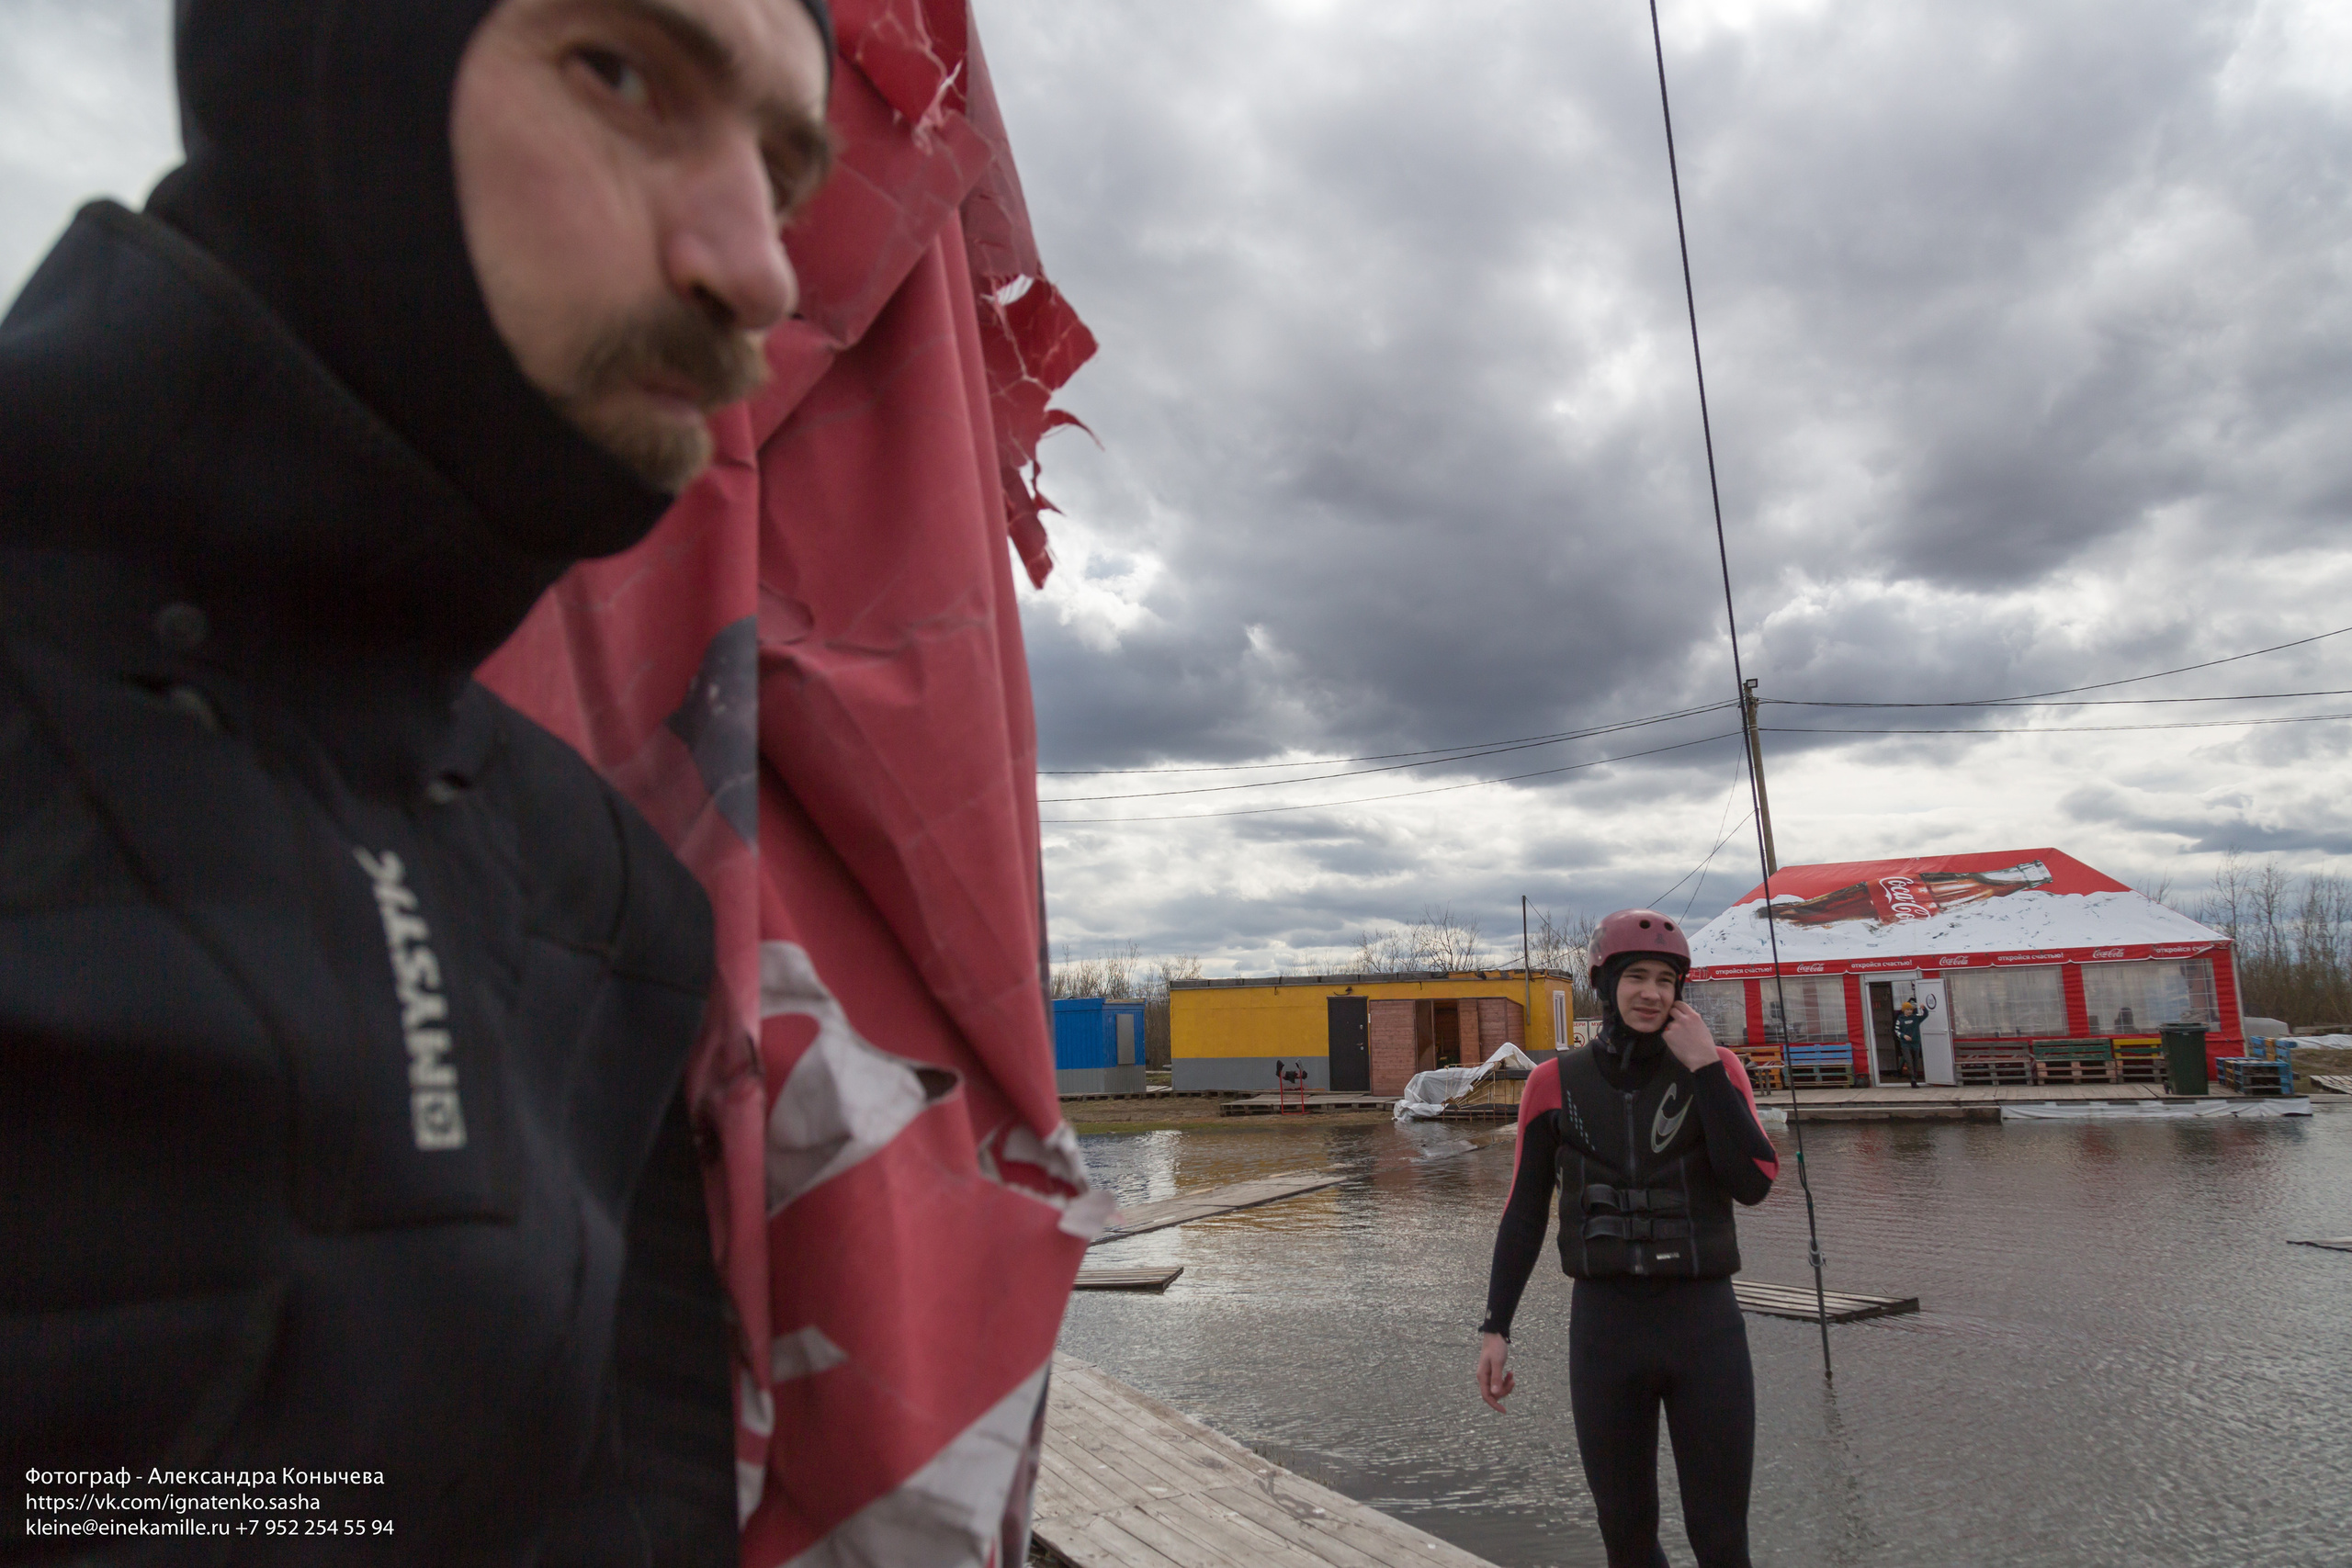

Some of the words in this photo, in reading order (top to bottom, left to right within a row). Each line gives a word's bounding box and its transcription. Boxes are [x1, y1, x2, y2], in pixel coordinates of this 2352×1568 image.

[1879, 876, 1931, 920] Coca-Co
[1997, 953, 2030, 962] откройся
[352, 844, 458, 1088] MYSTIC
[1851, 961, 1882, 969] откройся
[1882, 959, 1913, 967] счастью!
[1715, 967, 1744, 976] откройся
